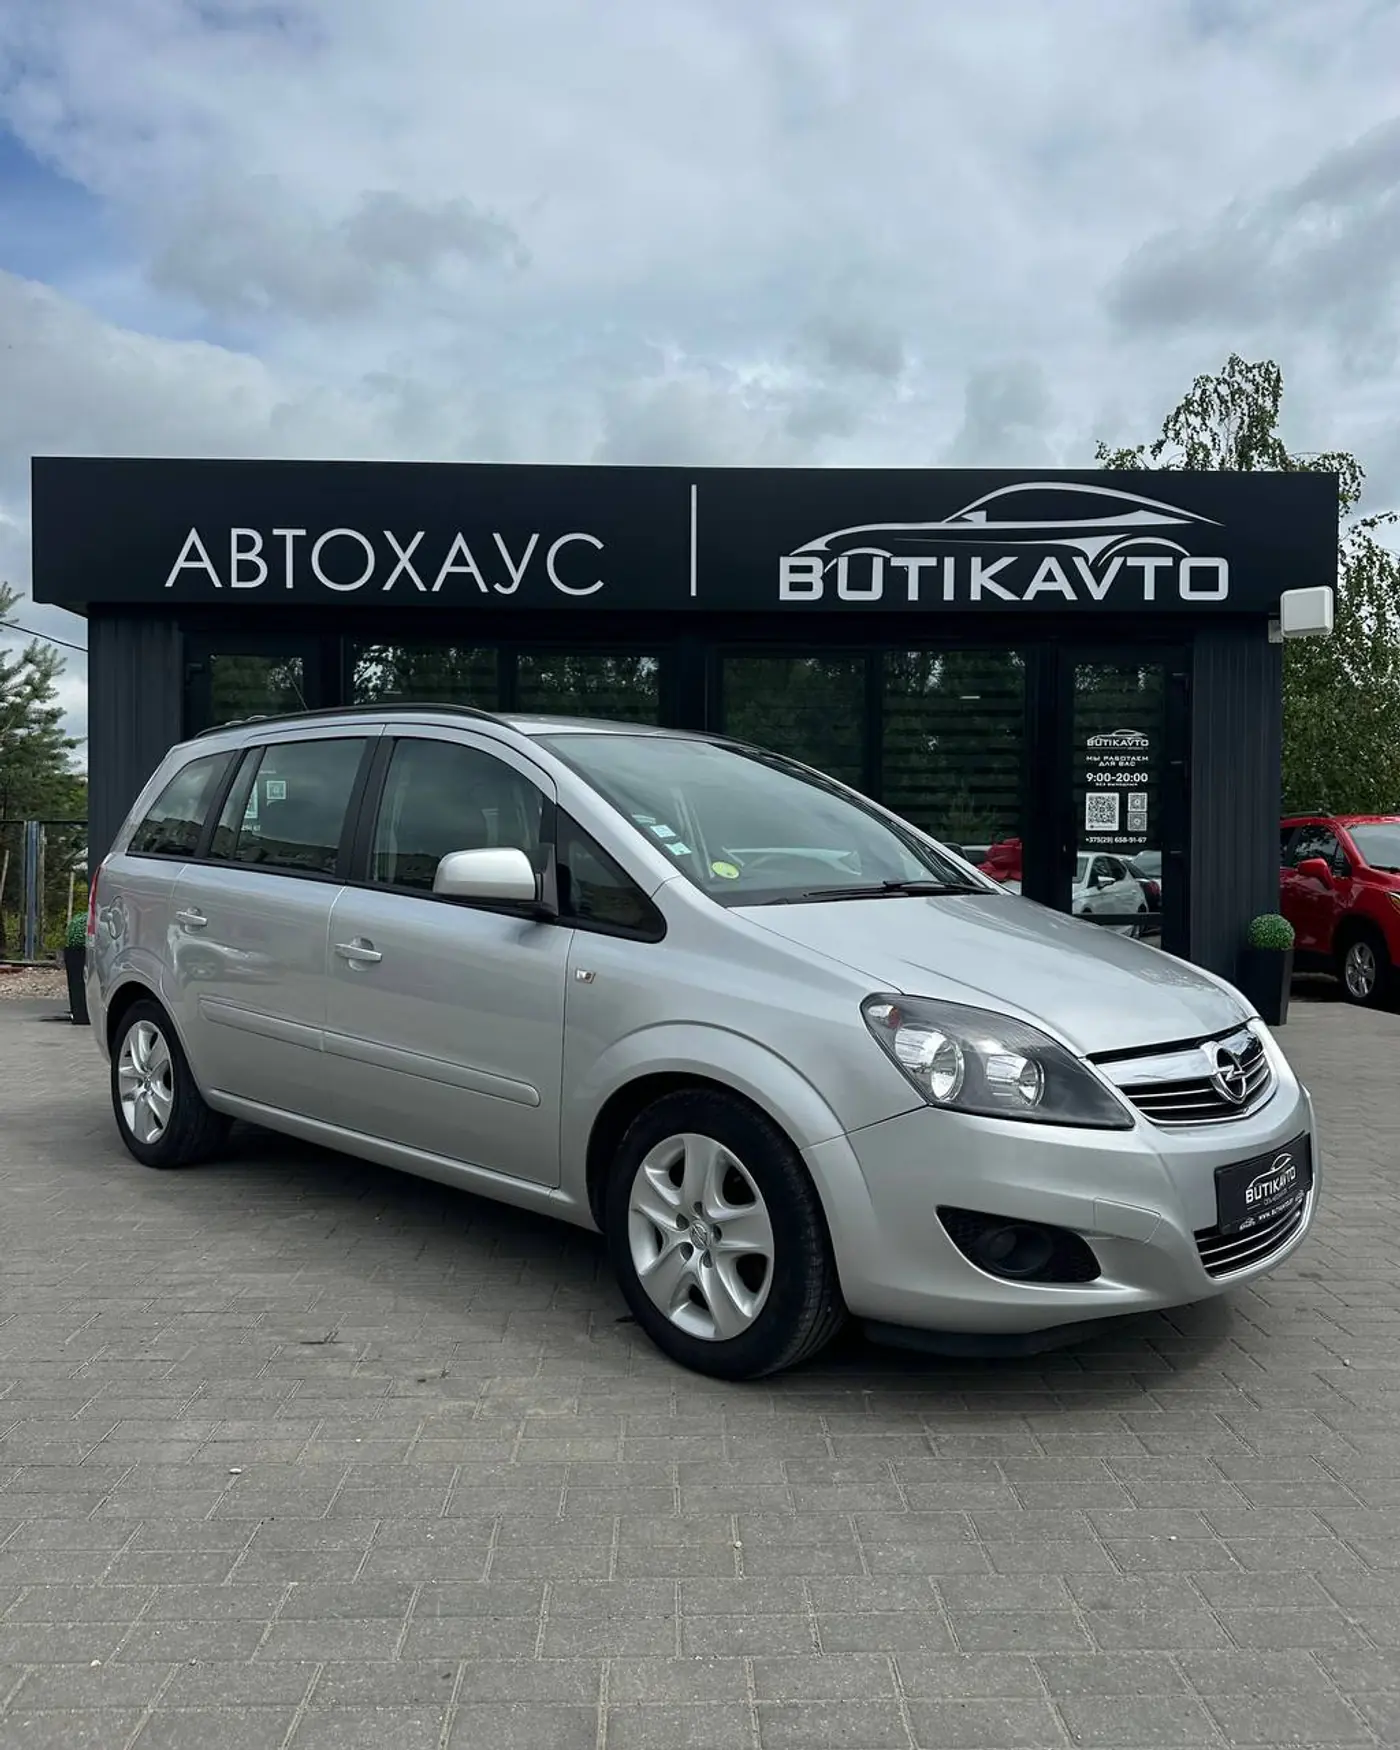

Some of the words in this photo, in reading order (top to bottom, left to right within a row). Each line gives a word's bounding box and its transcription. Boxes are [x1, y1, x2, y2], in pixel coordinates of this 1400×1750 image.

[164, 527, 605, 596] АВТОХАУС
[779, 555, 1230, 601] BUTIKAVTO
[1086, 738, 1150, 747] BUTIKAVTO
[1086, 772, 1149, 782] 9:00-20:00
